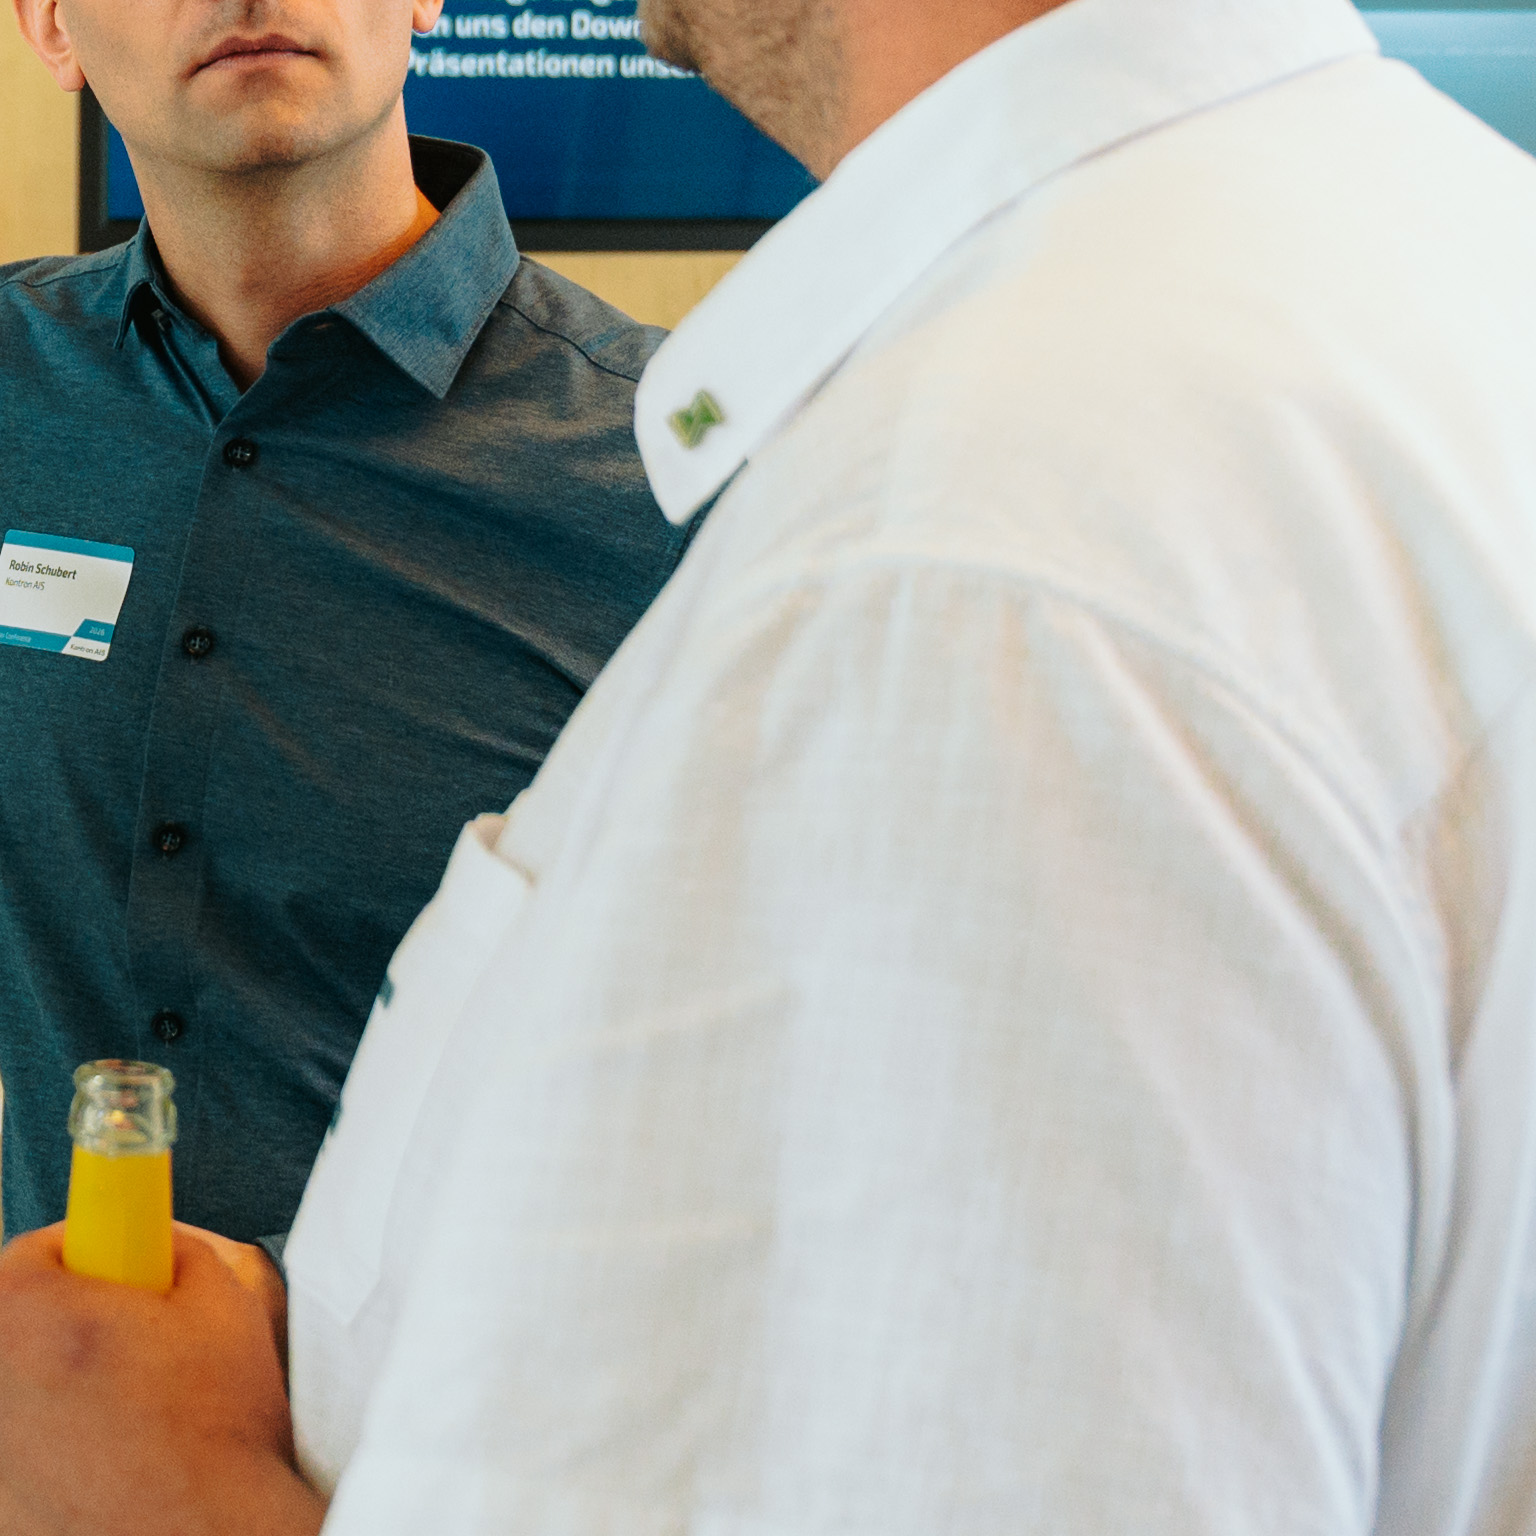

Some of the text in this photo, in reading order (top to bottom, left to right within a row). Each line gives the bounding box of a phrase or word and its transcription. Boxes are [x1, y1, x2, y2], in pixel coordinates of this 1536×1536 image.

[455, 14, 507, 39] uns
[512, 9, 566, 39] den
[9, 559, 77, 580] Robin Schubert
[5, 577, 46, 591] Kontron AIS
[70, 643, 94, 654] Kontron
